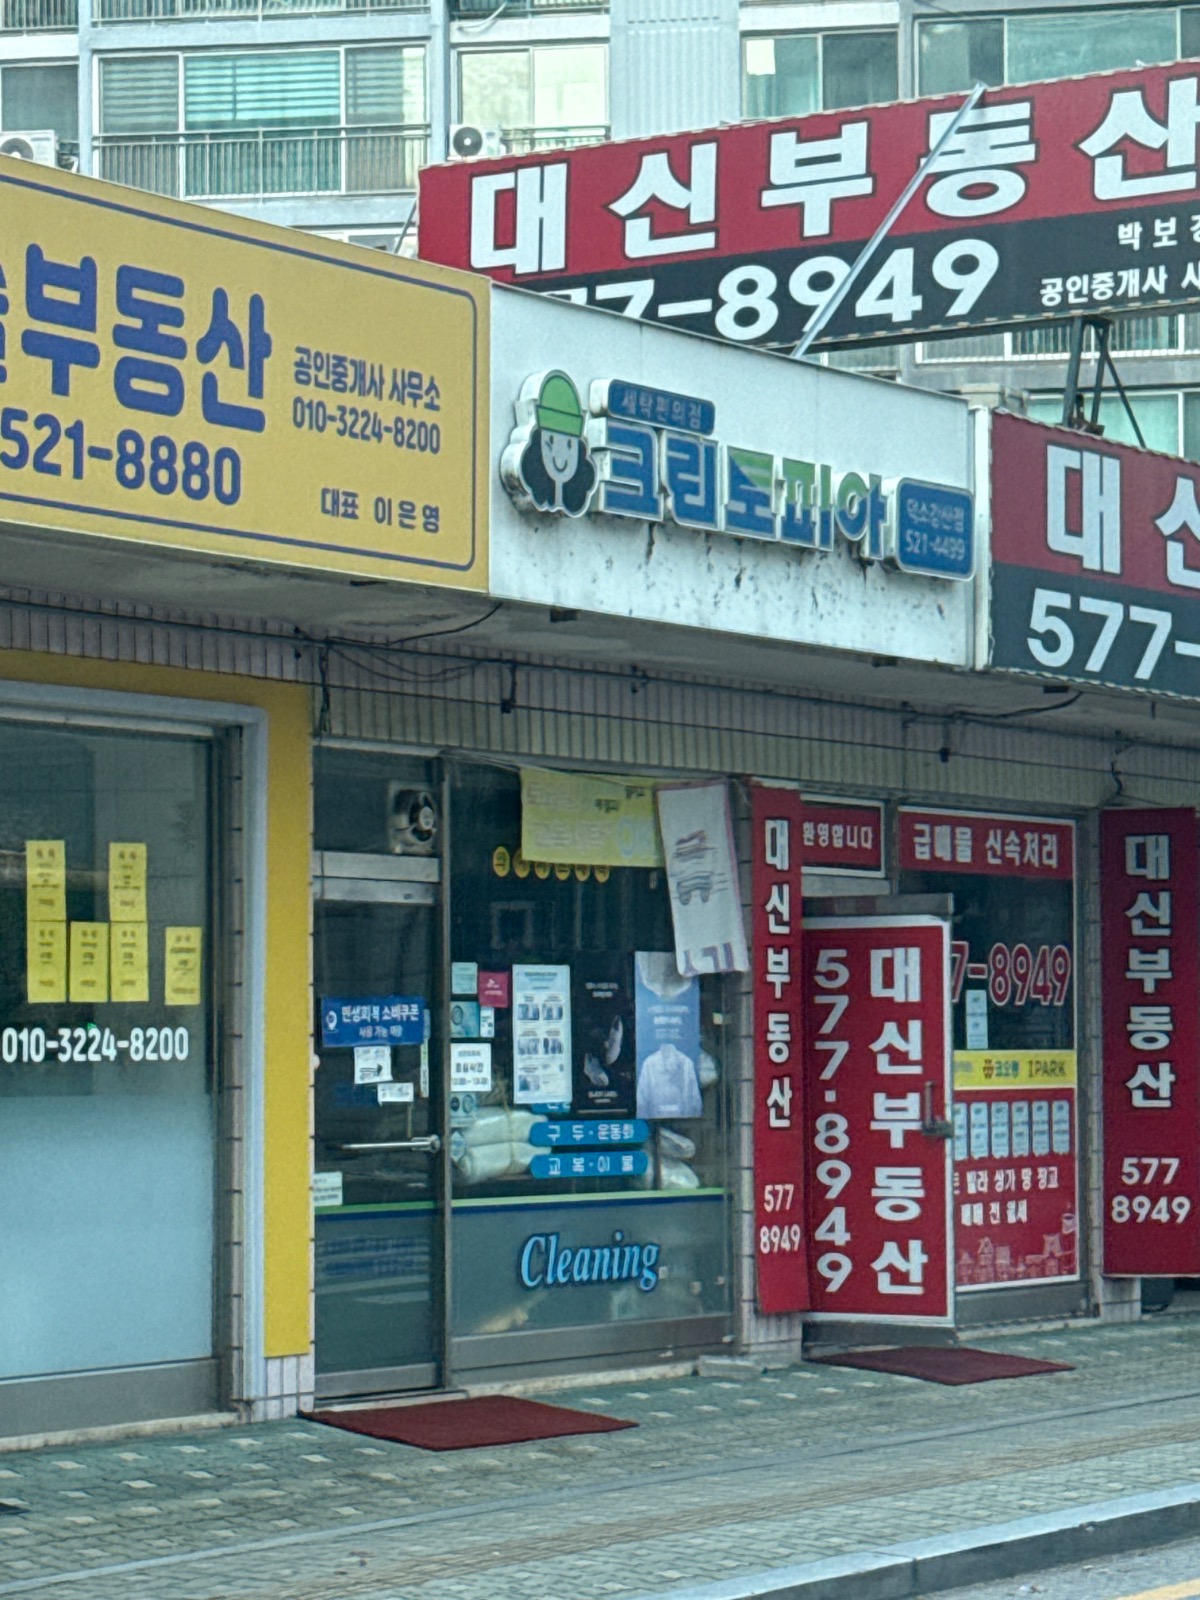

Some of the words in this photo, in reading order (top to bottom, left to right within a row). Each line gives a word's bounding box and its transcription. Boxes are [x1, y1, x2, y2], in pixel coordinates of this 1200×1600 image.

[469, 75, 1200, 275] 대신부동산
[1039, 265, 1168, 307] 공인중개사
[0, 243, 272, 433] 부동산
[293, 346, 385, 400] 공인중개사
[388, 368, 441, 412] 사무소
[292, 396, 441, 455] 010-3224-8200
[320, 487, 359, 520] 대표
[602, 417, 887, 560] 크린토피아
[912, 823, 972, 864] 급매물
[984, 828, 1059, 869] 신속처리
[764, 819, 793, 1128] 대신부동산
[1124, 834, 1176, 1109] 대신부동산
[1, 1026, 189, 1063] 010-3224-8200
[868, 946, 929, 1295] 대신부동산
[763, 1184, 794, 1212] 577
[1121, 1156, 1180, 1186] 577
[759, 1223, 801, 1254] 8949
[1111, 1195, 1191, 1225] 8949
[521, 1231, 660, 1292] Cleaning
